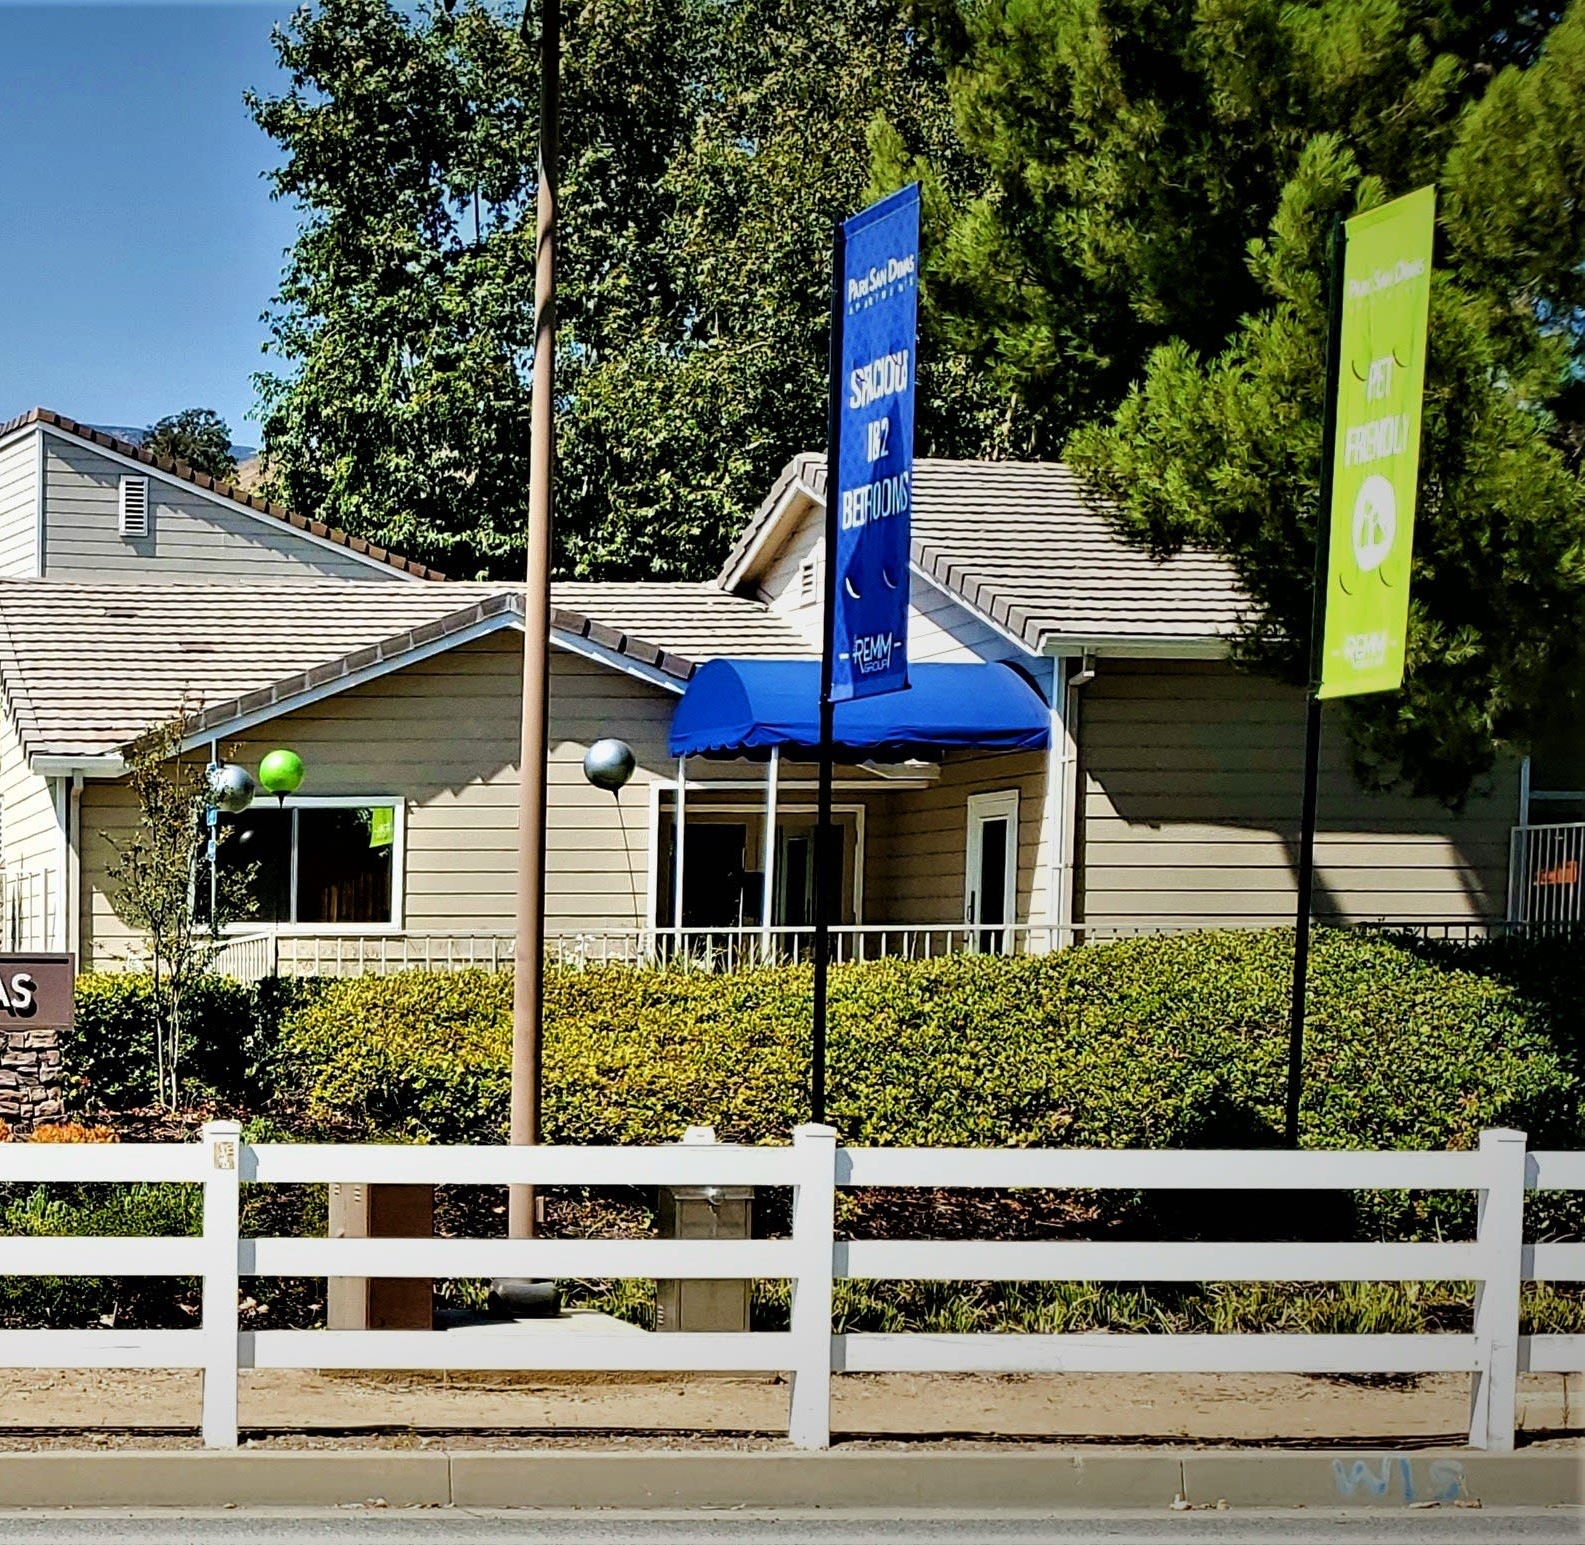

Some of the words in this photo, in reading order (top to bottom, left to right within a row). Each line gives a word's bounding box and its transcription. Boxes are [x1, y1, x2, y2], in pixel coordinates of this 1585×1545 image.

[1367, 354, 1394, 405] PET
[1345, 412, 1408, 468] FRIENDLY
[853, 632, 892, 673] REMM
